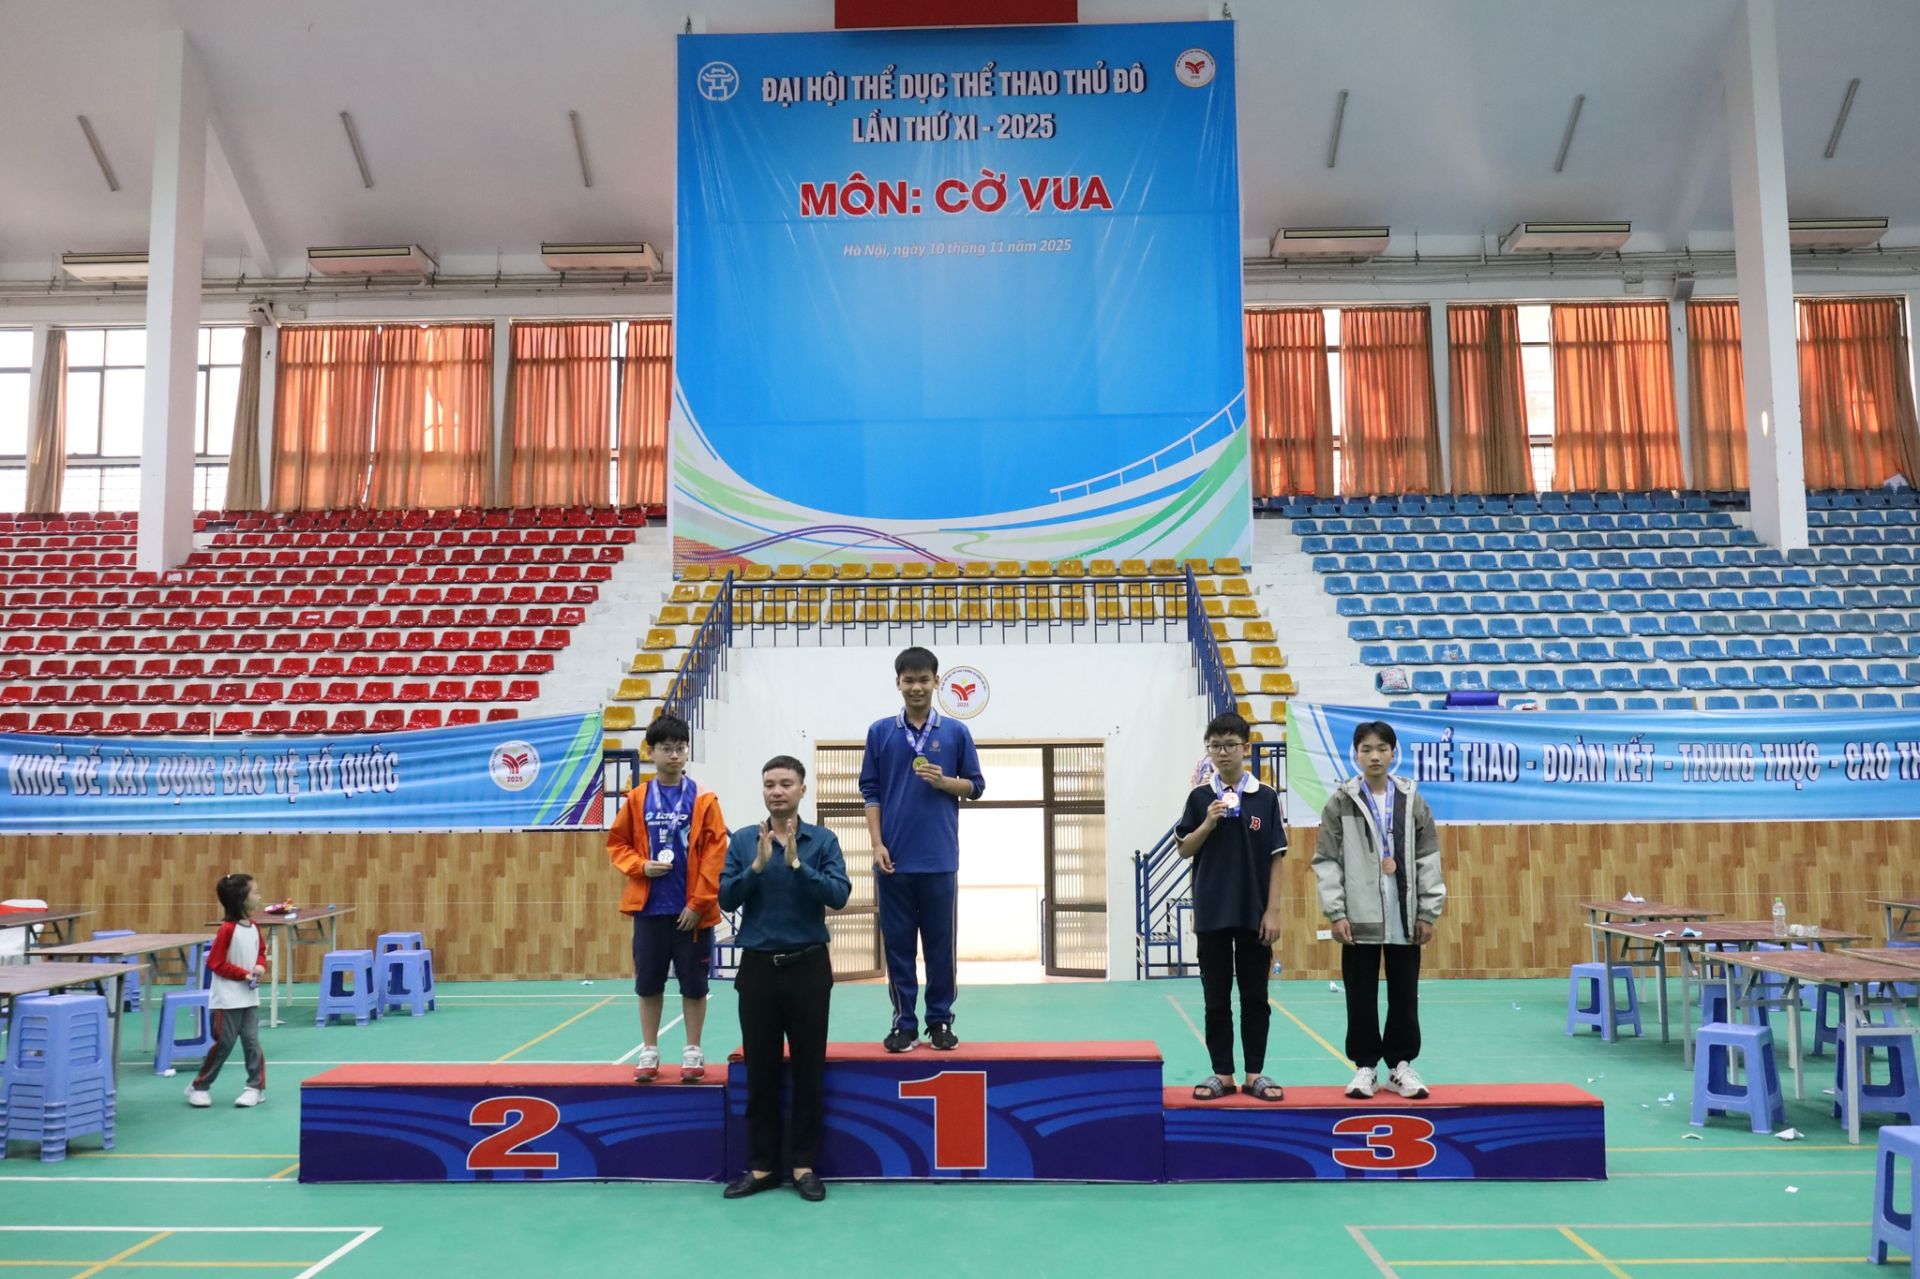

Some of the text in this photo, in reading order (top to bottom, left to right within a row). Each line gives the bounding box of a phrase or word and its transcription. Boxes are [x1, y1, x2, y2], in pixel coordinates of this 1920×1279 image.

[761, 59, 1147, 107] ĐẠI HỘI THỂ DỤC THỂ THAO THỦ ĐÔ
[852, 108, 900, 143] LẦN
[903, 110, 952, 142] THỨ
[953, 114, 979, 141] XI
[996, 113, 1057, 140] 2025
[800, 167, 1115, 217] MÔN: CỜ VUA
[843, 238, 1073, 260] Hà Nội, ngày 10 tháng 11 năm 2025
[107, 747, 150, 796] XÂY
[221, 747, 268, 796] BẢO
[272, 747, 301, 804] VỆ
[339, 742, 400, 799] QUỐC
[1410, 726, 1455, 782] THỂ
[1459, 742, 1520, 783] THAO
[1542, 735, 1607, 783] ĐOÀN
[1612, 733, 1656, 782] KẾT
[1678, 742, 1755, 782] TRUNG
[1760, 739, 1822, 790] THỰC
[1844, 741, 1891, 781] CAO
[466, 1095, 560, 1170] 2
[898, 1070, 987, 1170] 1
[1331, 1114, 1437, 1170] 3
